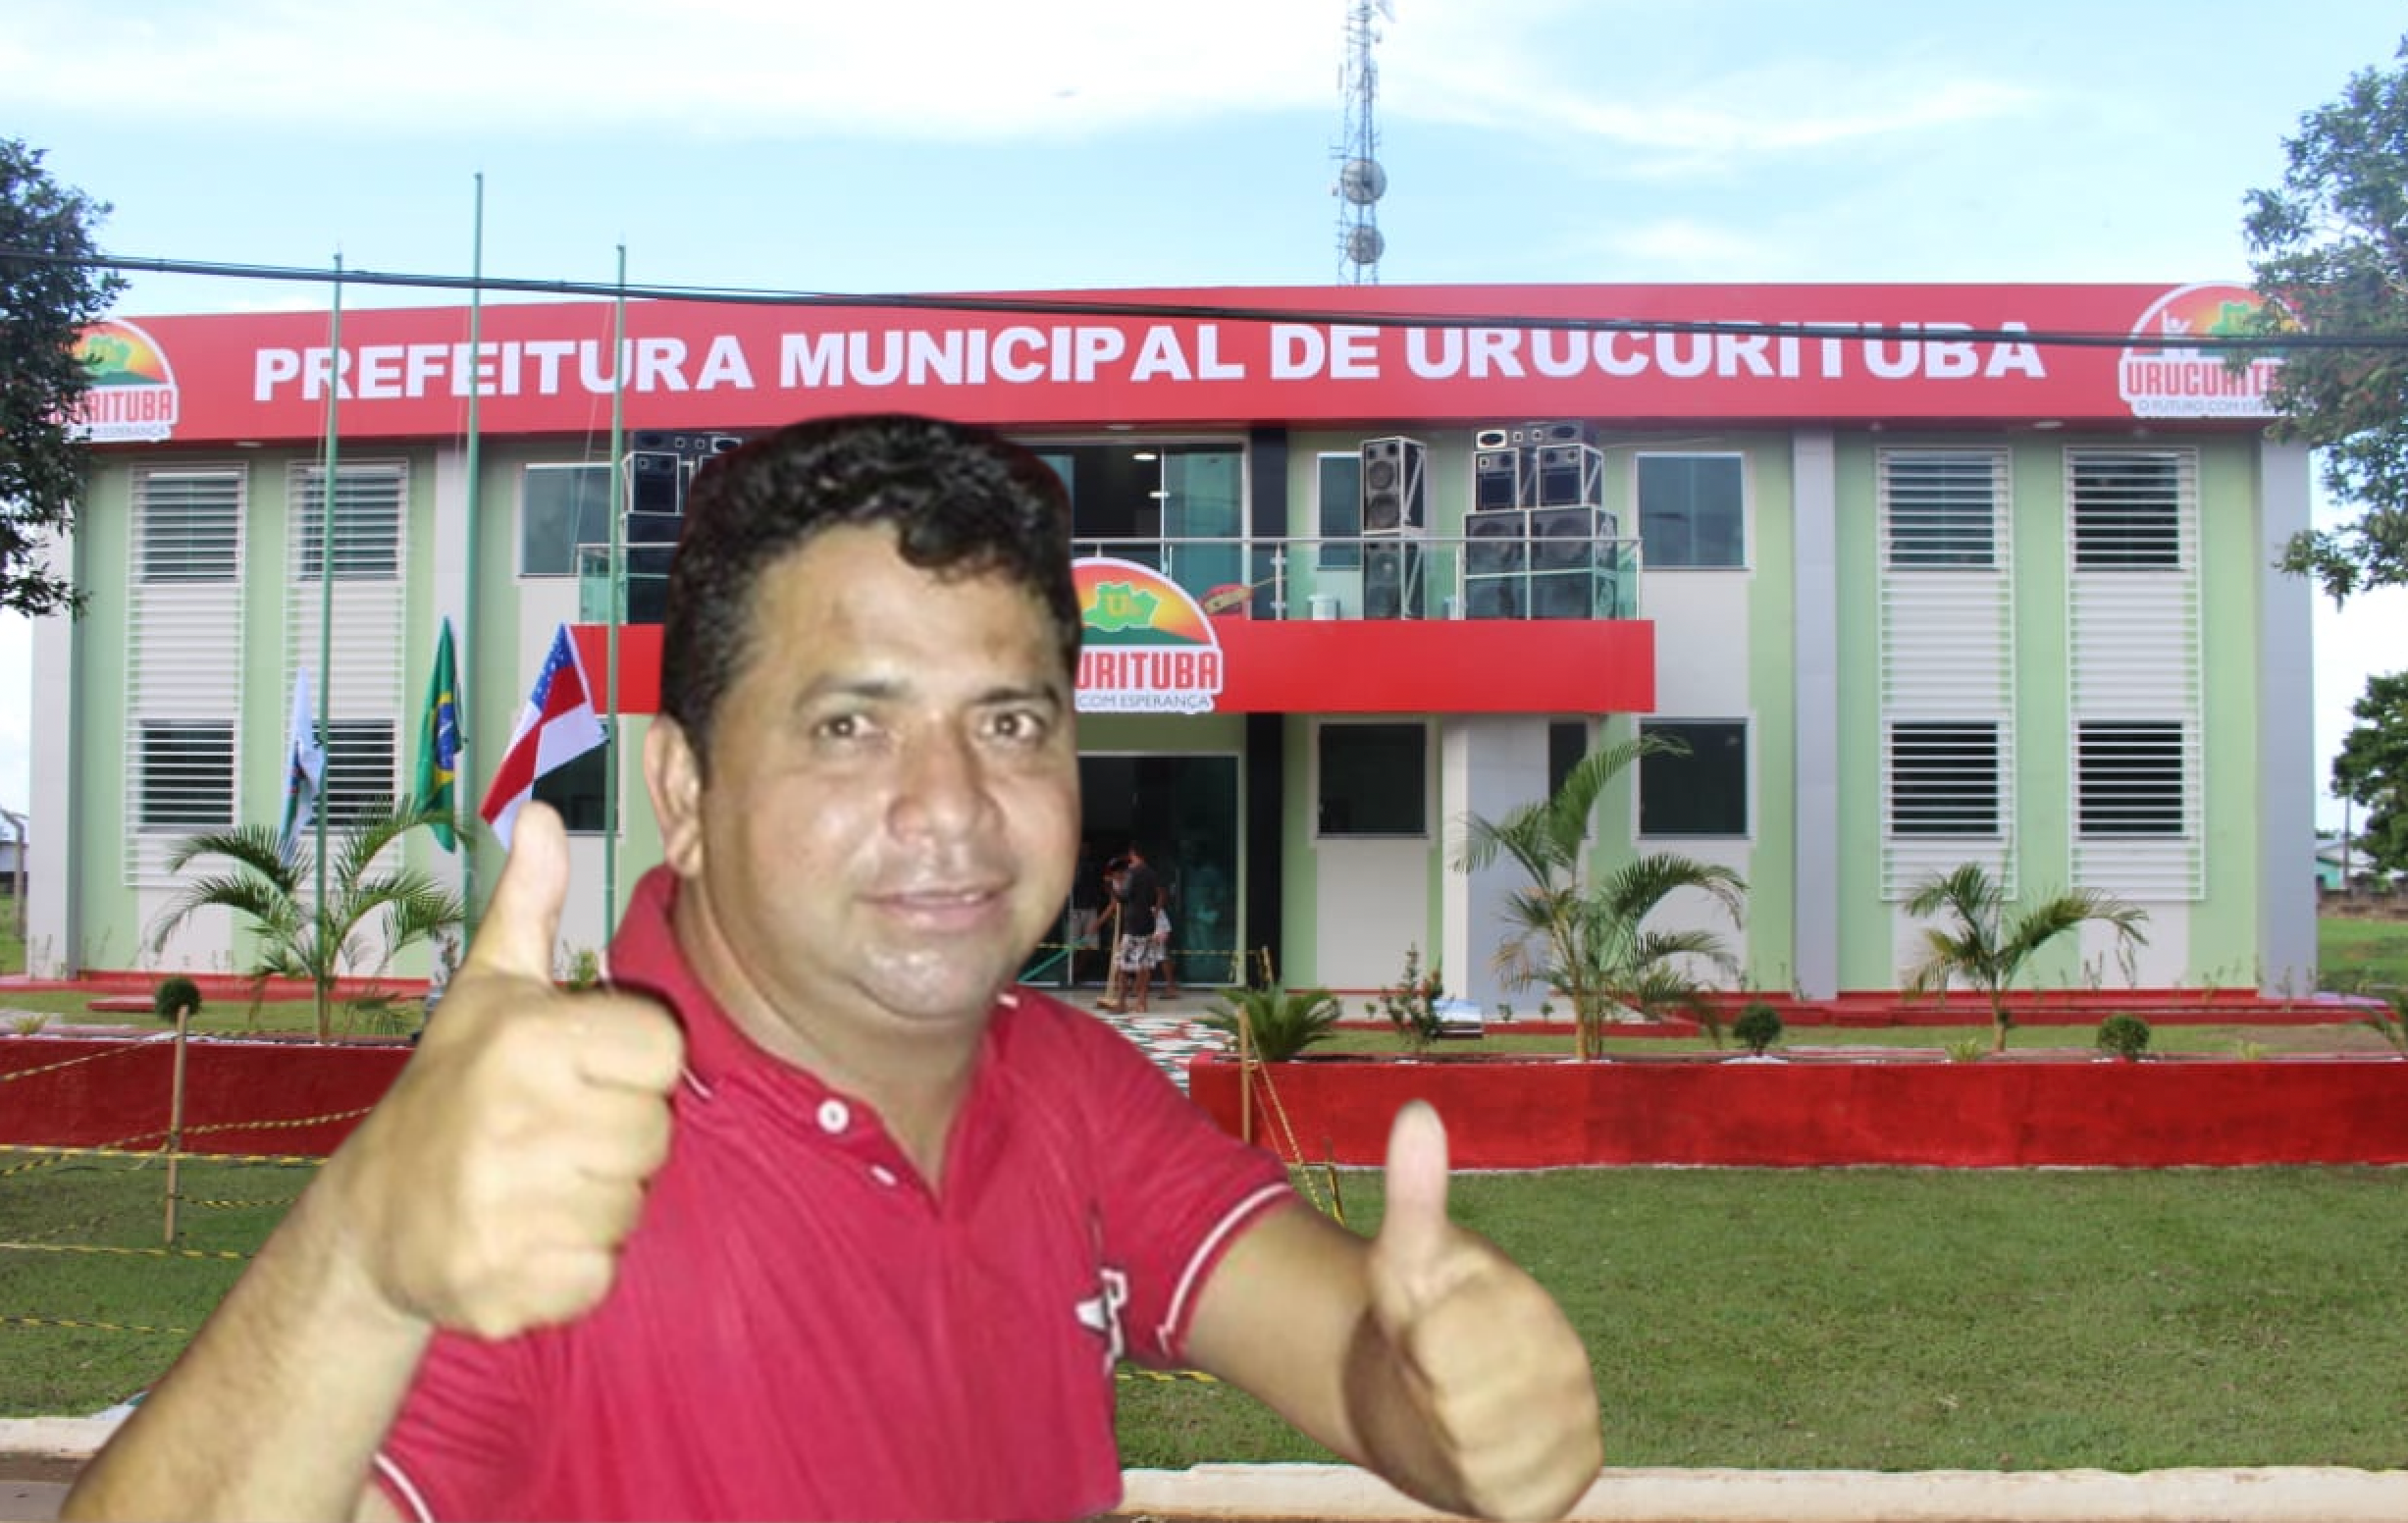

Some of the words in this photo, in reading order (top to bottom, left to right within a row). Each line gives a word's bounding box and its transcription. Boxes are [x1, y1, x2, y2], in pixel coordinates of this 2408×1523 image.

[252, 334, 755, 402] PREFEITURA
[779, 324, 1245, 389] MUNICIPAL
[1270, 324, 1380, 380] DE
[1404, 321, 2047, 380] URUCURITUBA
